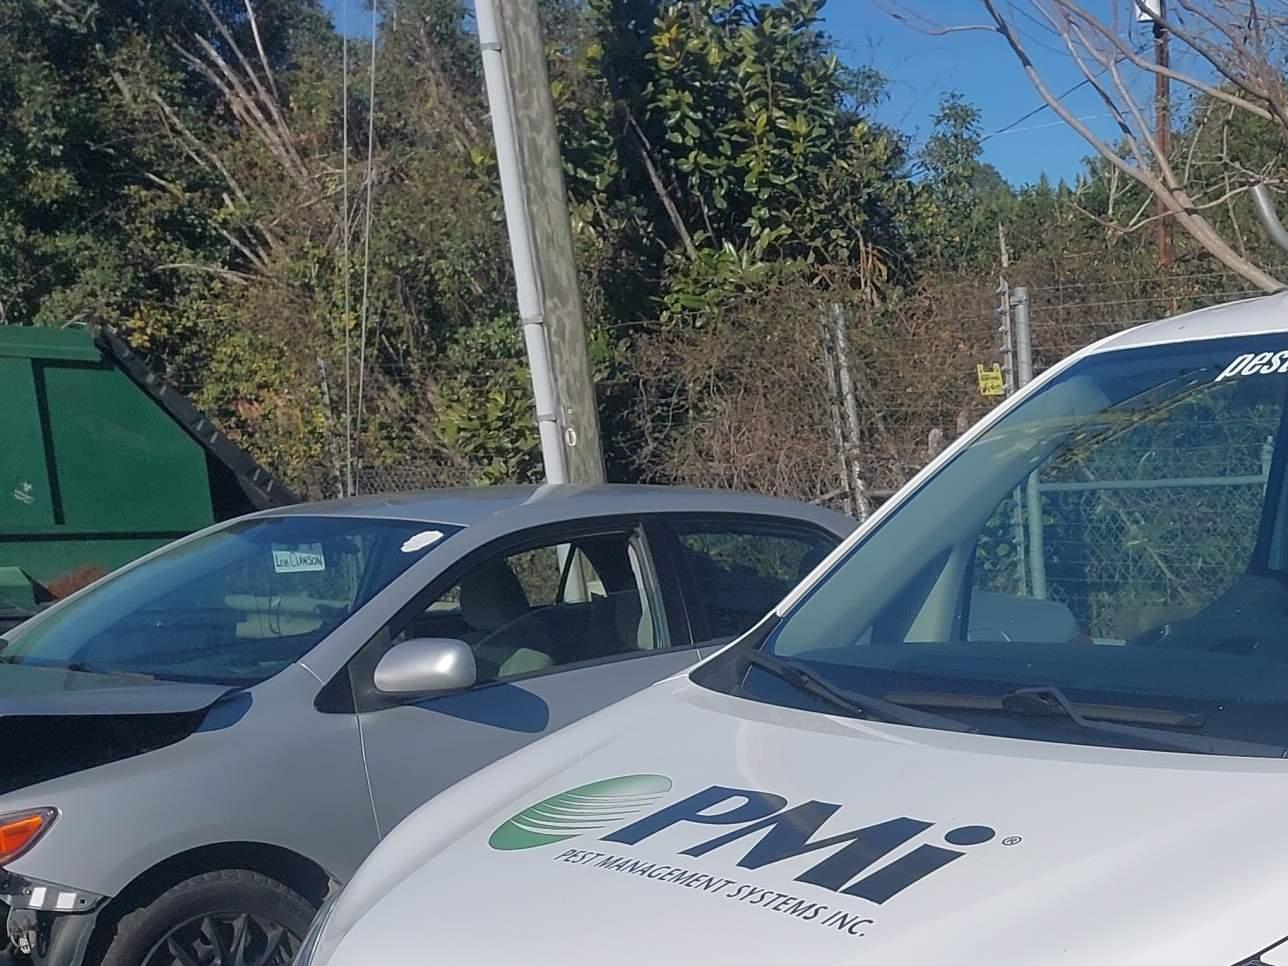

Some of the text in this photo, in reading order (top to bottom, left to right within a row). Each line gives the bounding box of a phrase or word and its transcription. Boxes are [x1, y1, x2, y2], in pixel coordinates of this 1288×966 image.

[553, 849, 876, 938] PEST MANAGEMENT SYSTEMS INC.
